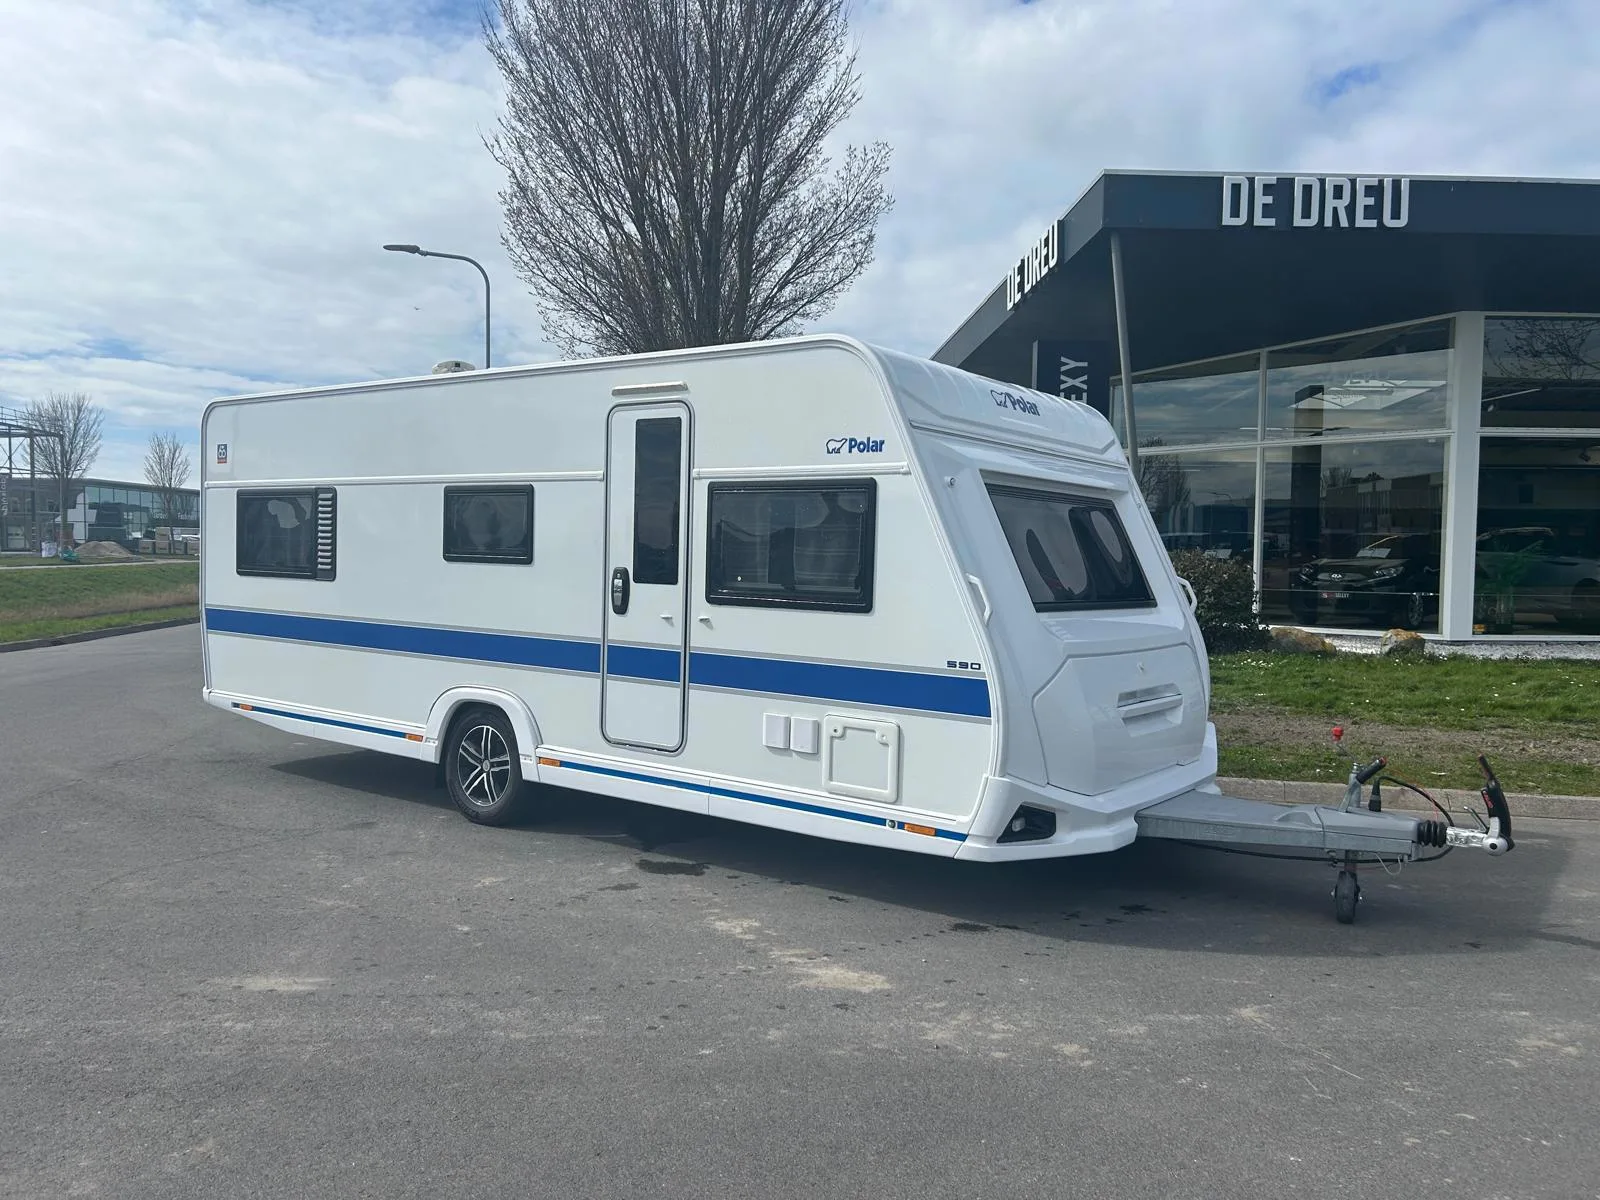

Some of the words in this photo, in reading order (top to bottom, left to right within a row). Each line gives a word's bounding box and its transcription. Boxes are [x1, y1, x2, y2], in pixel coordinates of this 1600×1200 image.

[1222, 176, 1277, 226] DE
[1293, 177, 1409, 227] DREU
[1007, 259, 1021, 311] DE
[1024, 219, 1058, 294] DREU
[1007, 392, 1040, 416] Polar
[848, 436, 885, 454] Polar
[946, 660, 981, 670] 590
